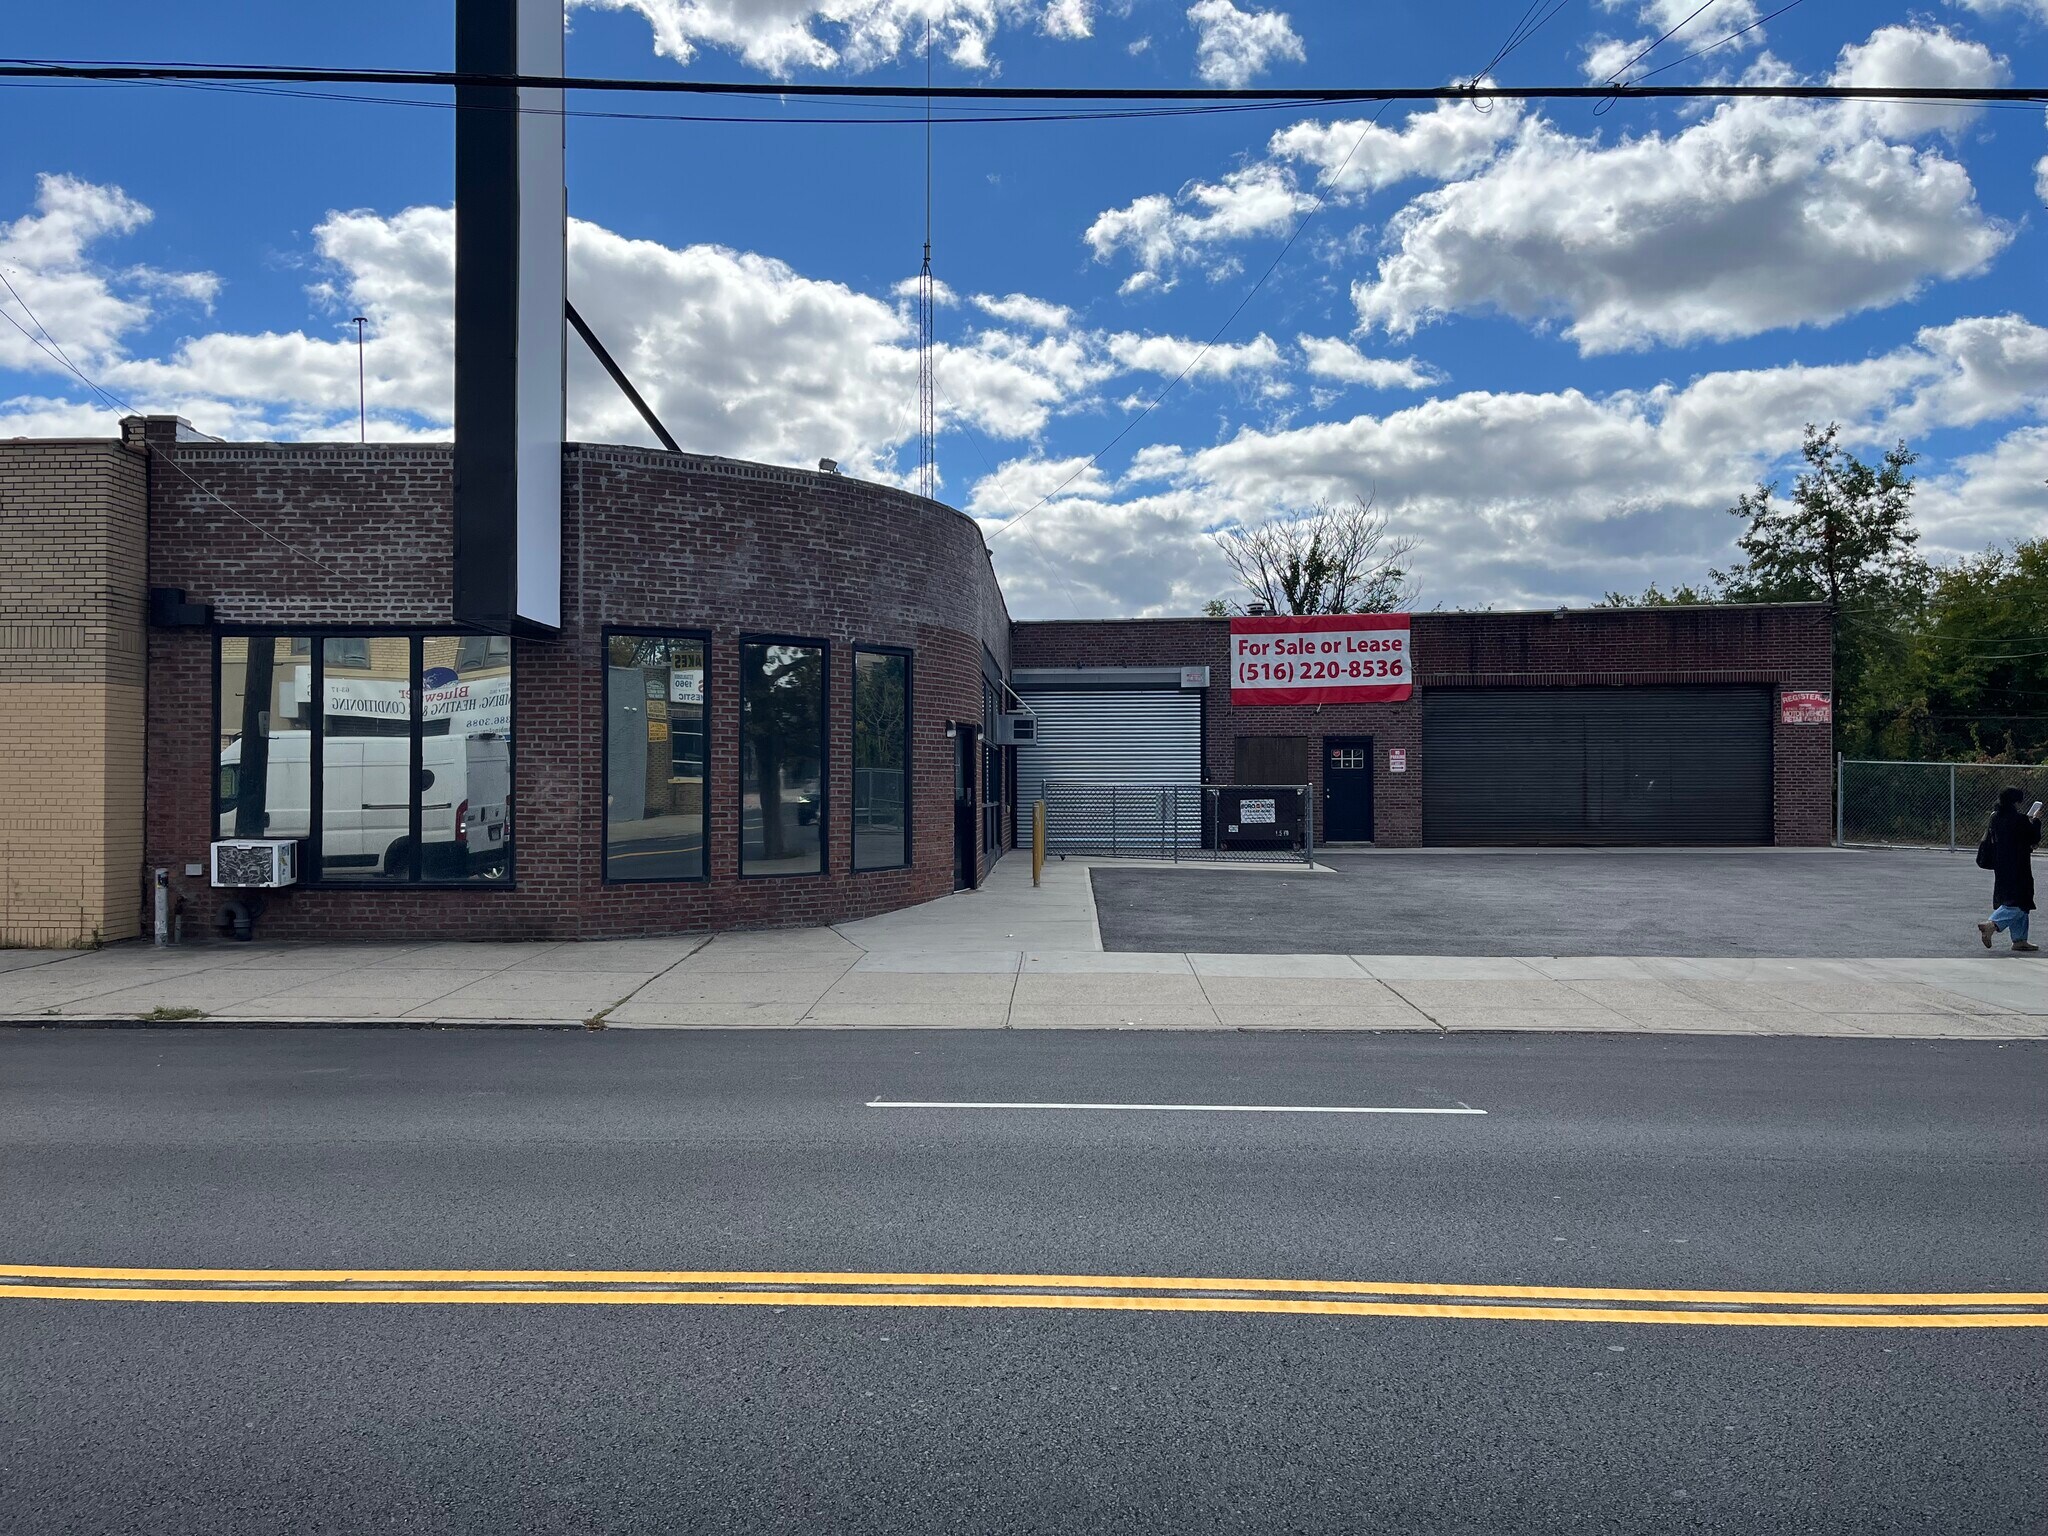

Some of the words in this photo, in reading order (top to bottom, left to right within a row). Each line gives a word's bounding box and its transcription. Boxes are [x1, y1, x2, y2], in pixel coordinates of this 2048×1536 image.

[1238, 639, 1269, 655] For
[1274, 637, 1315, 655] Sale
[1320, 641, 1341, 654] or
[1346, 636, 1402, 653] Lease
[1239, 661, 1294, 683] (516)
[1299, 659, 1403, 680] 220-8536
